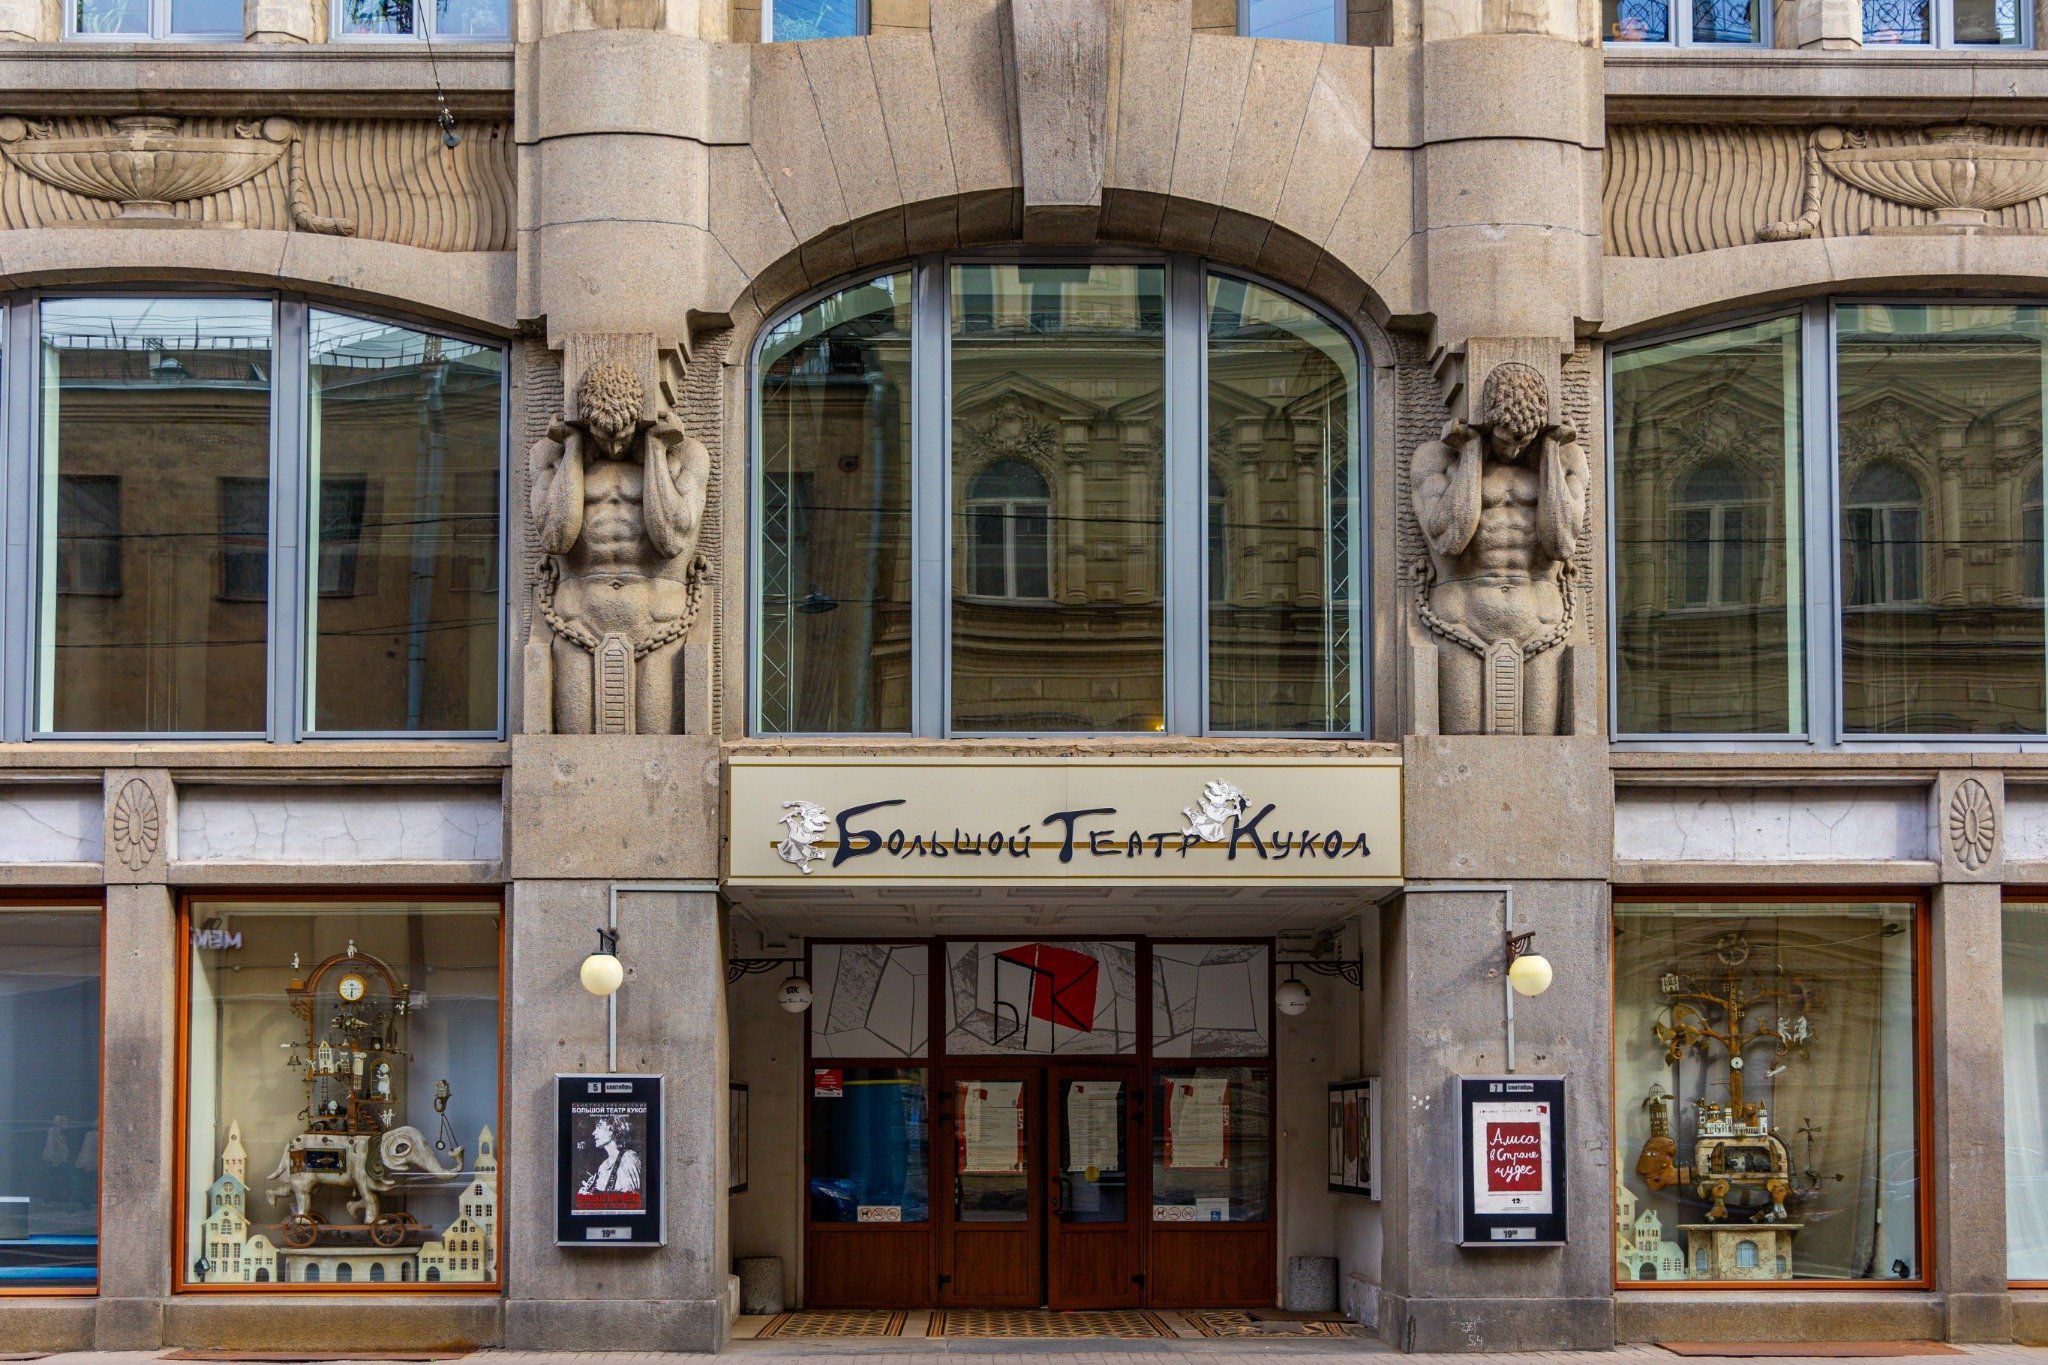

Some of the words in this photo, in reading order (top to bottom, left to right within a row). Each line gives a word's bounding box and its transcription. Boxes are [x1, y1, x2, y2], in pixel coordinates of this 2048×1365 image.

[593, 1083, 599, 1091] 5
[1494, 1084, 1499, 1092] 7
[571, 1106, 605, 1114] БОЛЬШОЙ
[1490, 1128, 1539, 1145] Алиса
[1497, 1148, 1539, 1165] Стране
[1495, 1165, 1536, 1182] чудес
